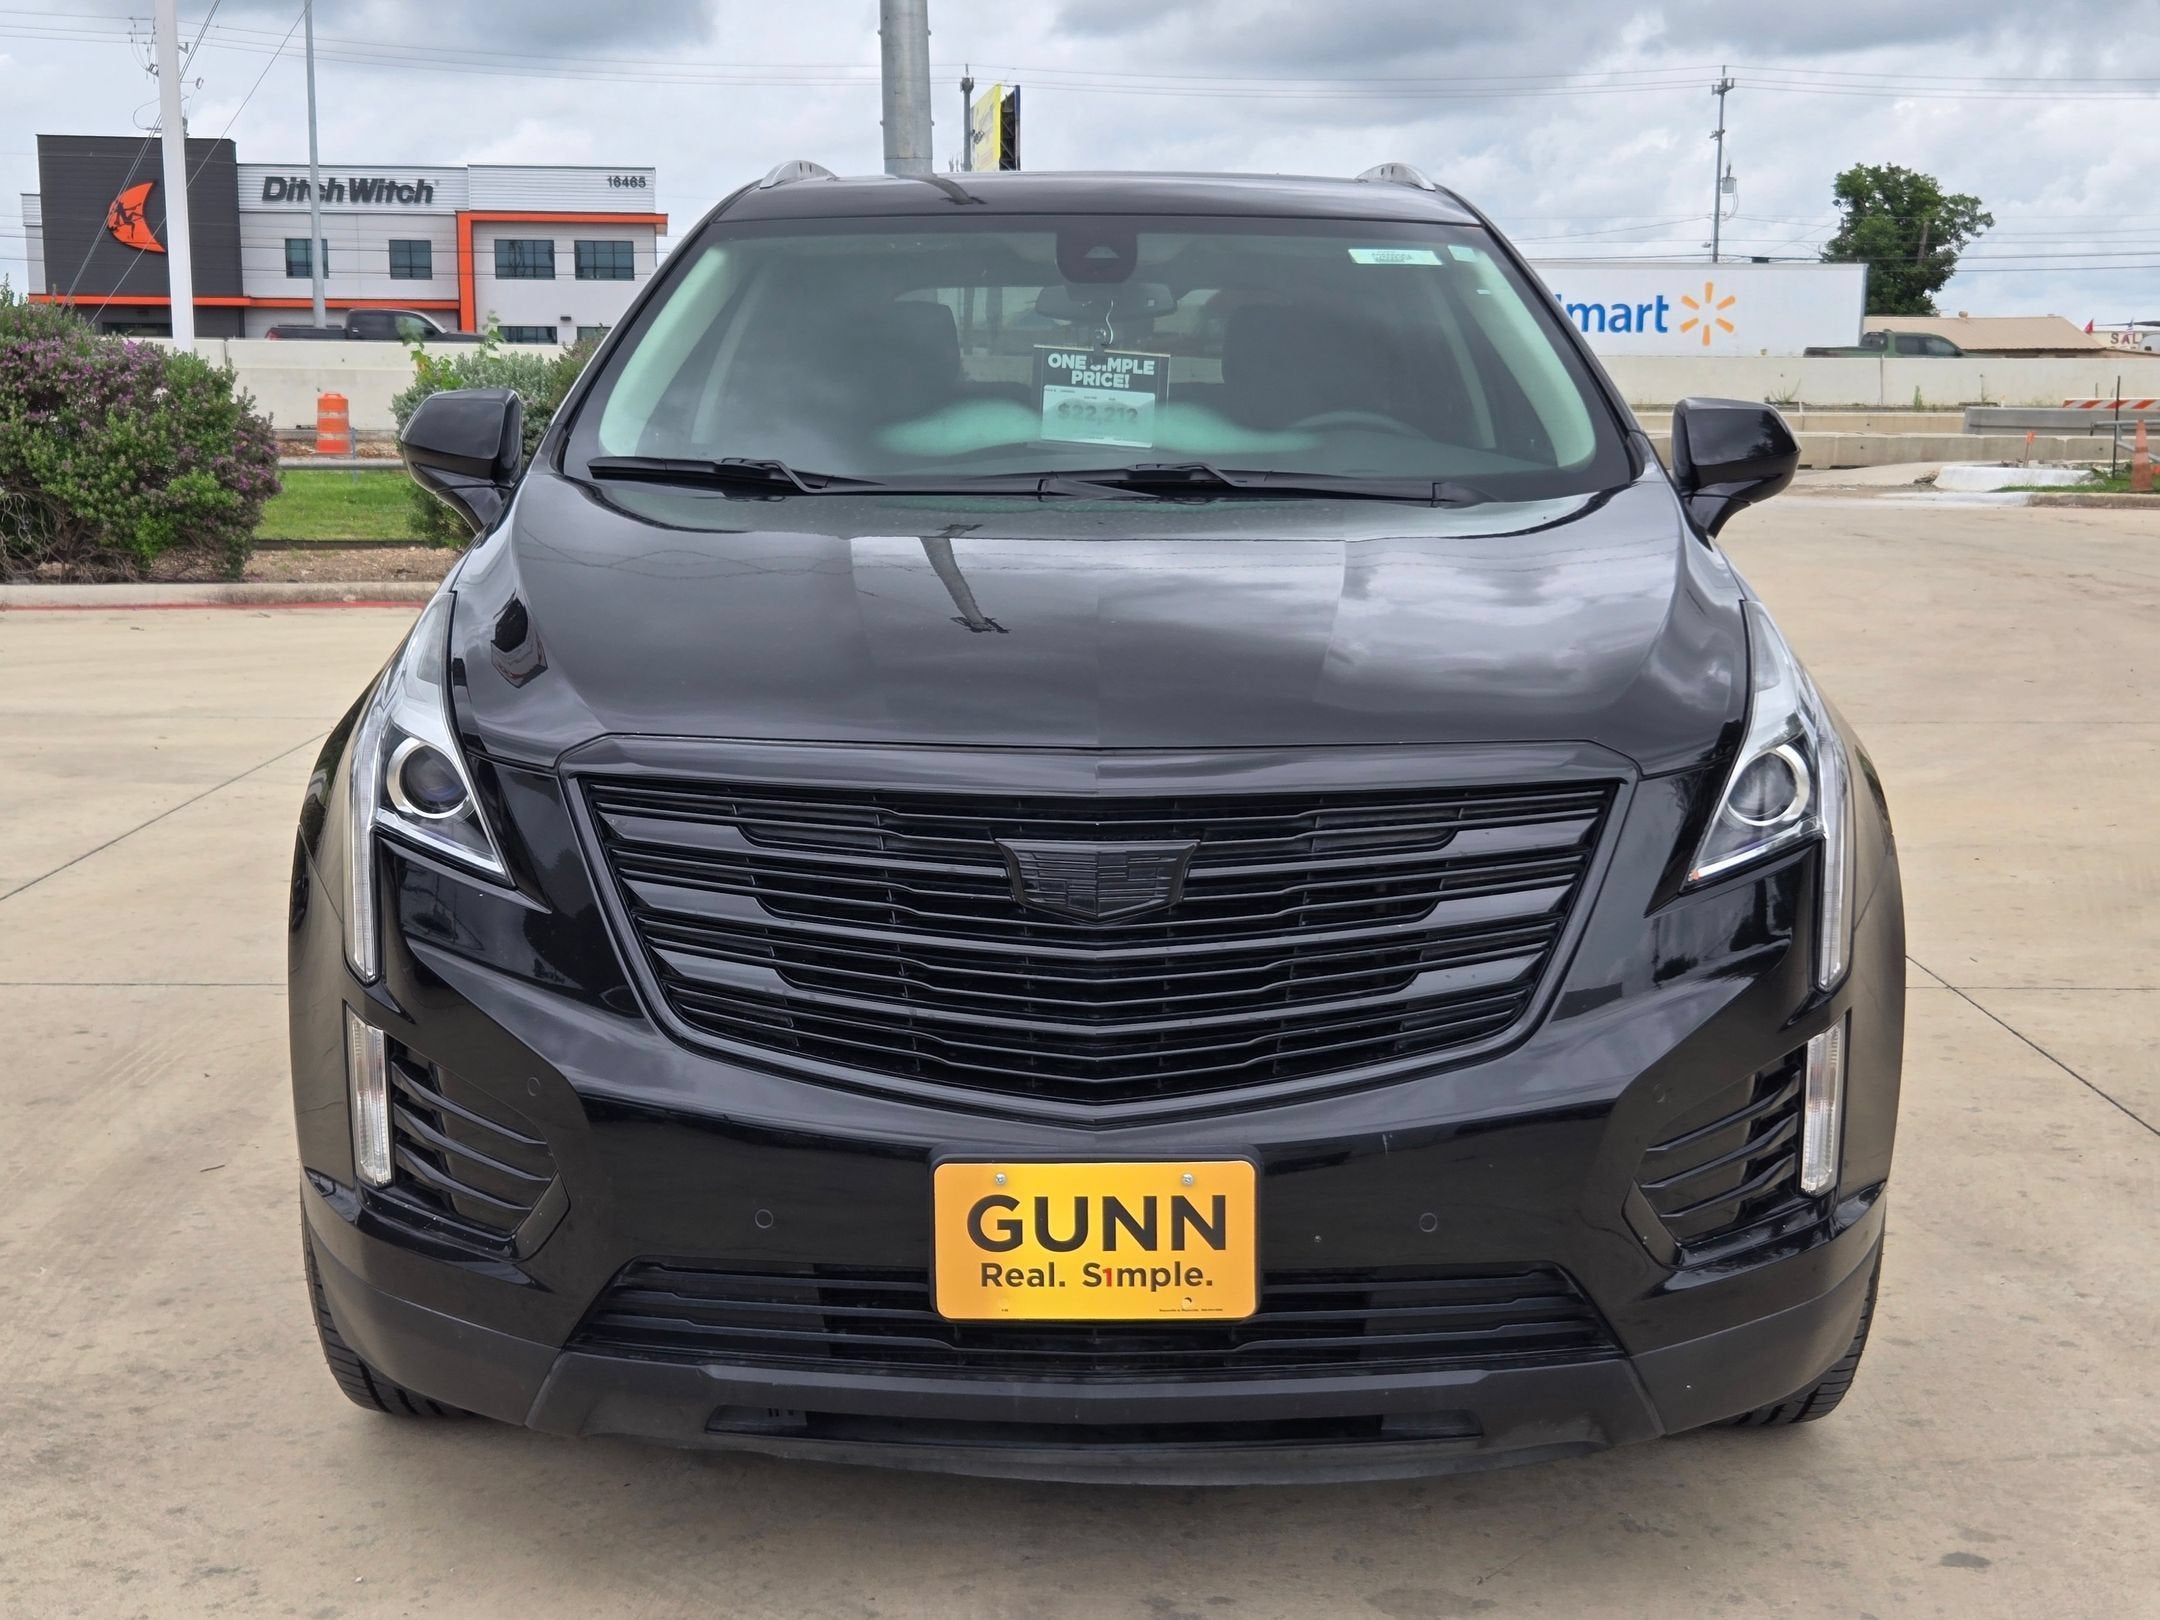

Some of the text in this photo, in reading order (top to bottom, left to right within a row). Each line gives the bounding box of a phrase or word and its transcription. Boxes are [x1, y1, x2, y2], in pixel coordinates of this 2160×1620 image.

[350, 178, 434, 204] Witch
[607, 175, 646, 188] 16465
[1047, 353, 1087, 370] ONE
[1071, 370, 1130, 389] PRICE!
[966, 1194, 1226, 1253] GUNN
[981, 1261, 1066, 1288] Real.
